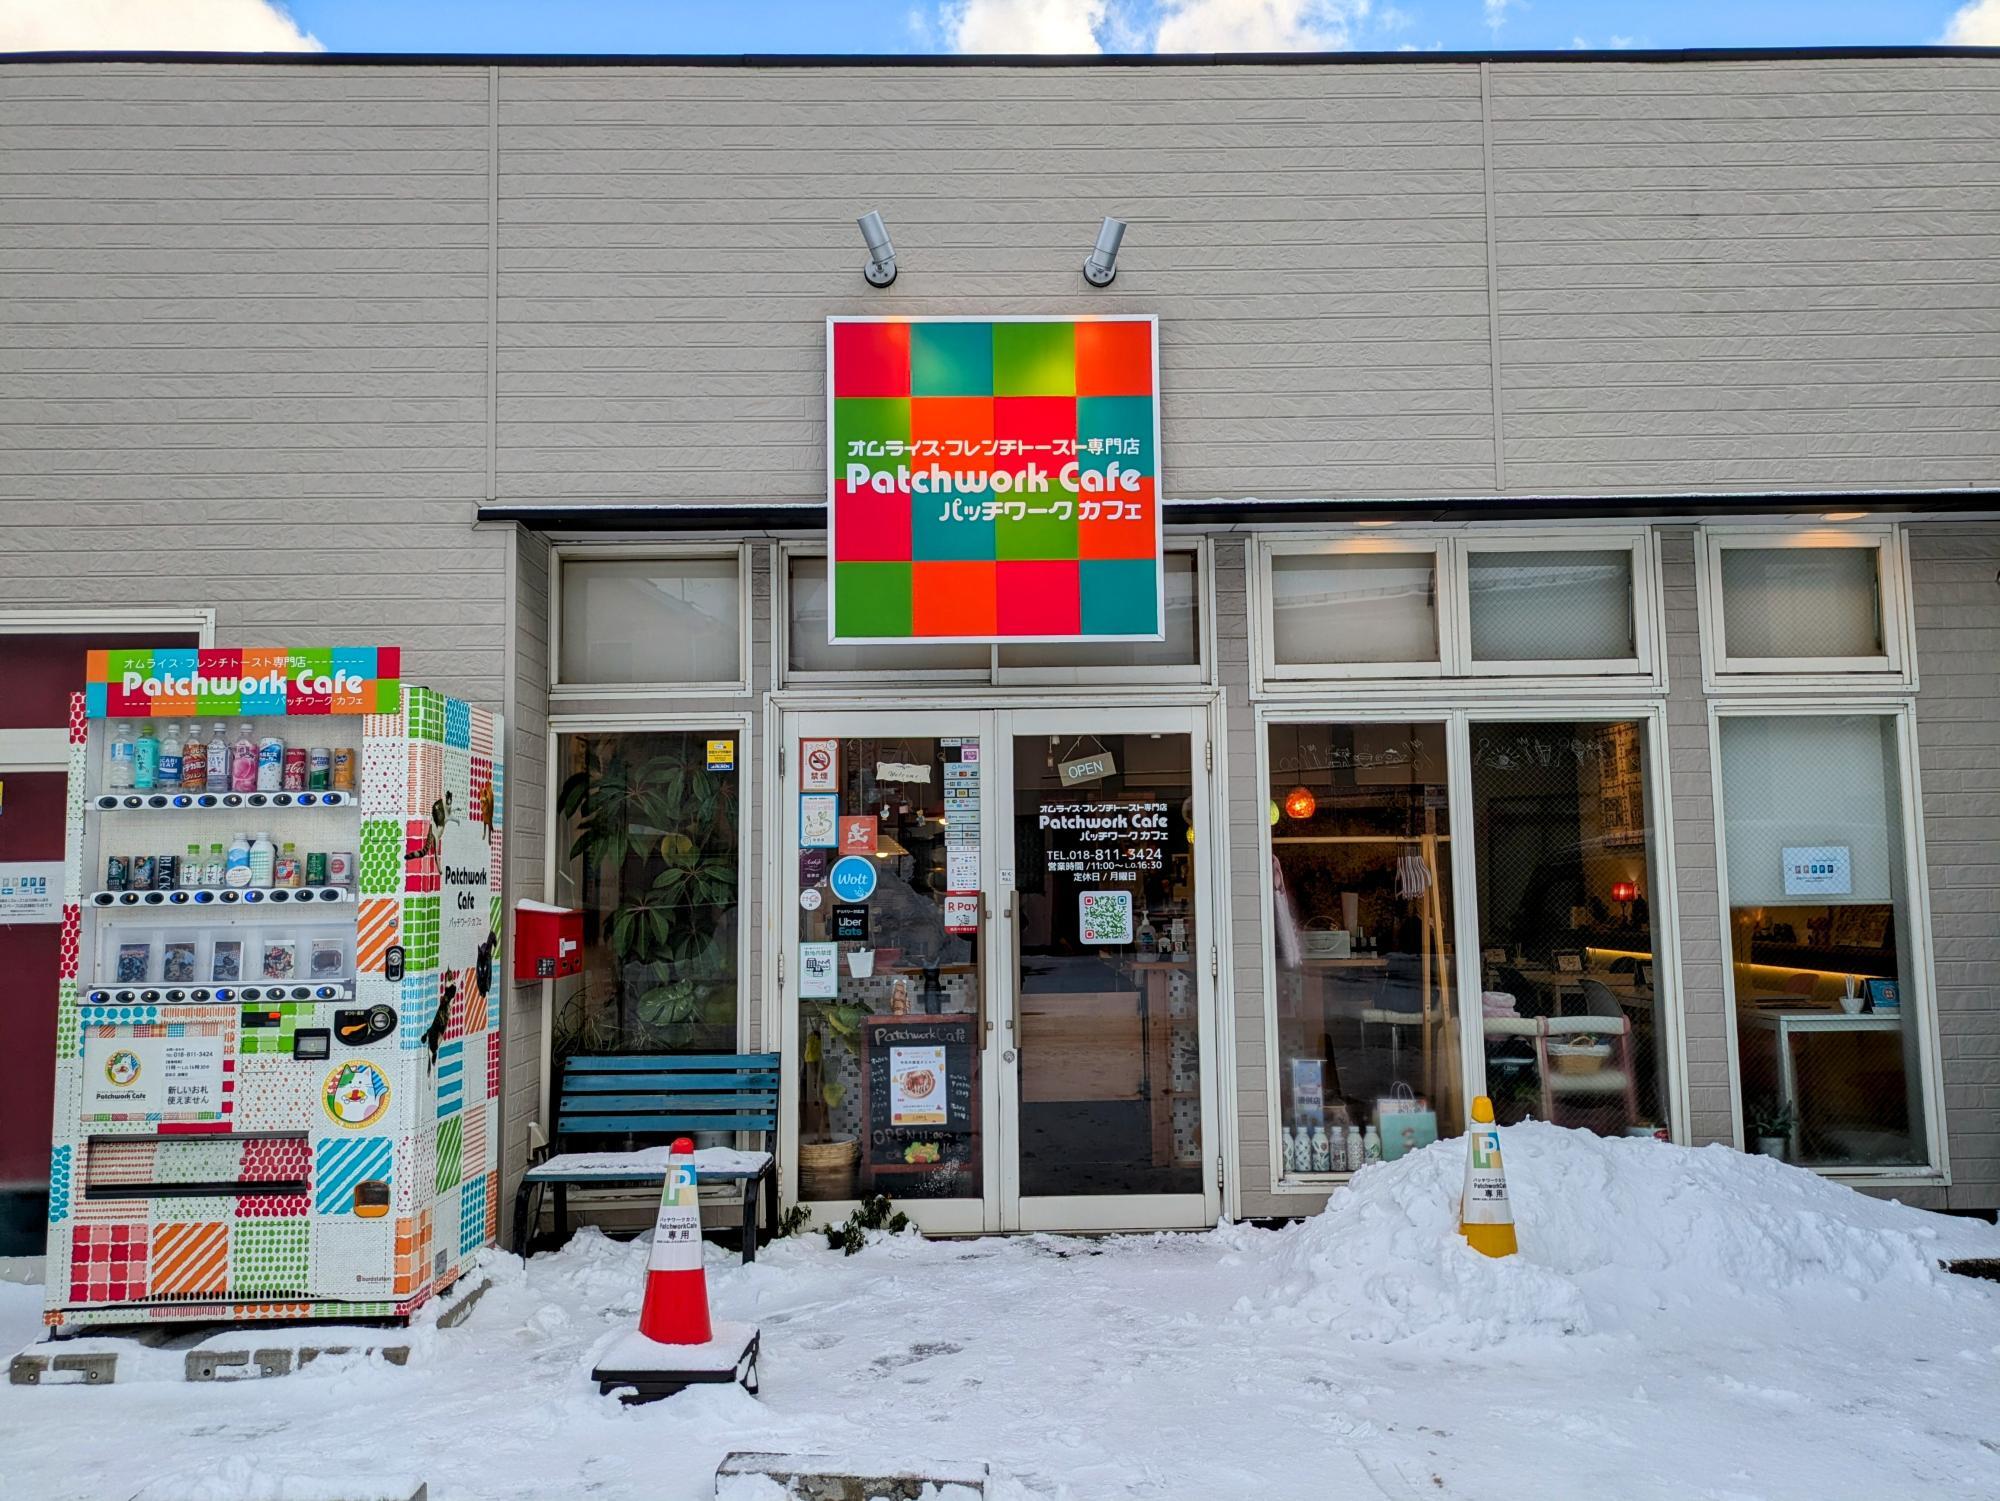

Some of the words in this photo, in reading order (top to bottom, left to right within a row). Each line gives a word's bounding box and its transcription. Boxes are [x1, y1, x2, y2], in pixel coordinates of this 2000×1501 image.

[847, 438, 1140, 457] オムライス・フレンチトースト専門店
[846, 462, 1049, 494] Patchwork
[1059, 461, 1141, 493] Cafe
[938, 499, 1072, 522] パッチワーク
[1077, 500, 1142, 521] カフェ
[124, 656, 307, 669] オムライス・フレンチトースト専門店
[122, 669, 287, 697] Patchwork
[296, 669, 363, 695] Cafe
[1068, 760, 1104, 780] OPEN
[1039, 814, 1127, 830] Patchwork
[1132, 814, 1168, 828] Cafe
[1080, 831, 1138, 842] パッチワーク
[1140, 831, 1168, 840] カフェ
[1047, 848, 1162, 861] TEL.018-811-3424
[158, 856, 172, 890] BLACK
[1048, 862, 1084, 872] 営業時間
[445, 866, 487, 886] Patchwork
[838, 873, 868, 885] Wolt
[1073, 872, 1100, 882] 定休日
[1110, 872, 1136, 881] 月曜日
[458, 890, 474, 910] Cafe
[838, 918, 862, 926] Uber
[838, 927, 862, 936] Eats
[168, 1086, 208, 1094] 新しいお札
[167, 1096, 209, 1105] 使えません
[1479, 1136, 1498, 1164] P
[669, 1170, 691, 1200] P
[668, 1230, 689, 1240] 専用
